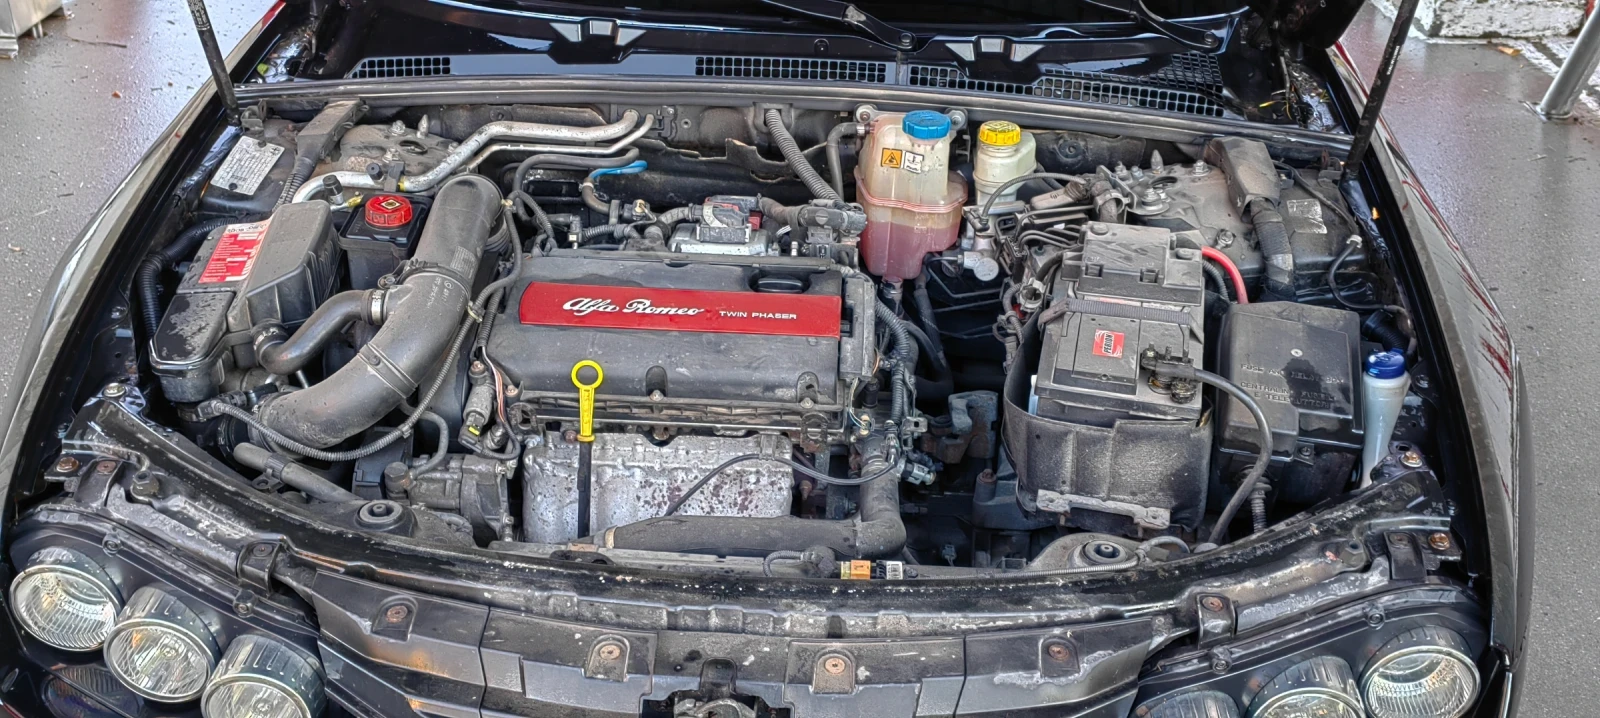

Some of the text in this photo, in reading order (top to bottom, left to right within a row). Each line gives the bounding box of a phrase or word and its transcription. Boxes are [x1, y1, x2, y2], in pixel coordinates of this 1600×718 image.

[562, 298, 797, 320] Alfa Romeo TWIN PHASER
[1240, 363, 1264, 373] FUSE
[1240, 381, 1294, 395] CENTRALIN
[1266, 393, 1331, 409] TELEUTTORI
